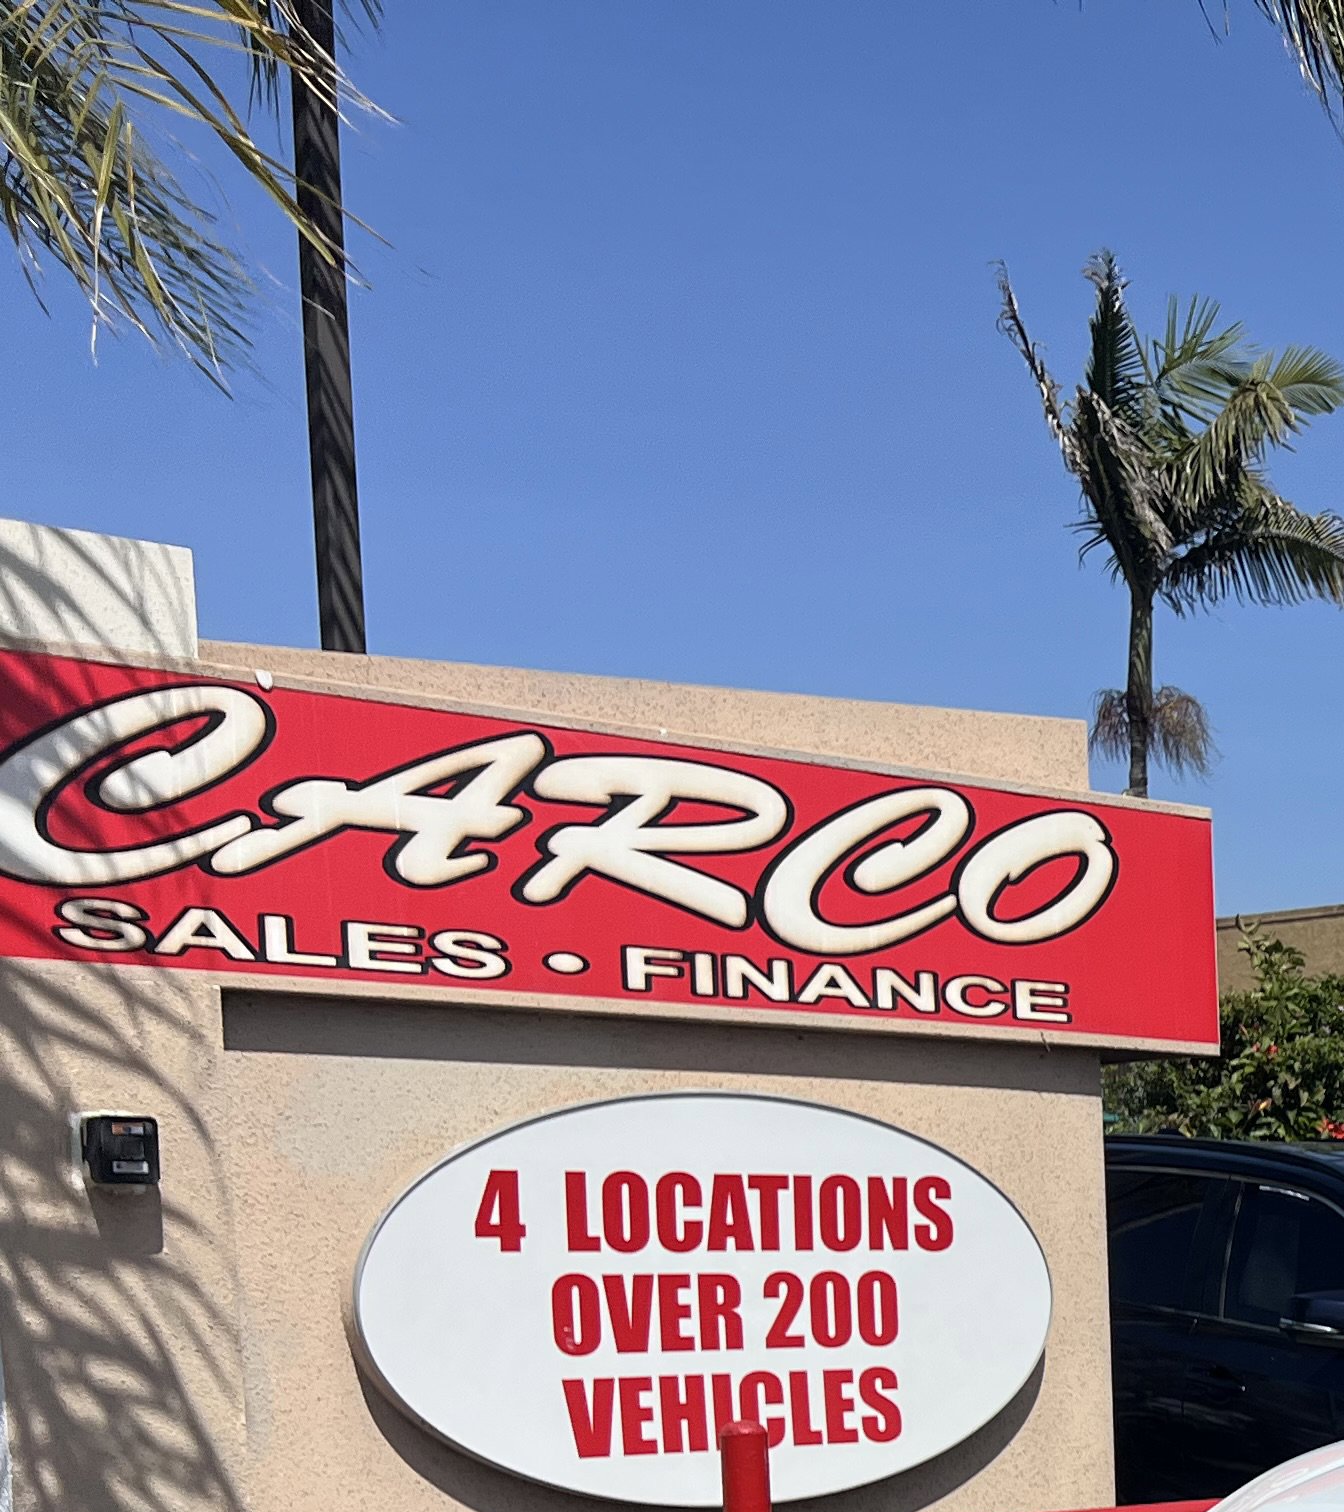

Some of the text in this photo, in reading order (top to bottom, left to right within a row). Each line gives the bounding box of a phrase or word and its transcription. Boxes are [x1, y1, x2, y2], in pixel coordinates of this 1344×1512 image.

[0, 681, 1118, 956] CARCO
[53, 897, 1072, 1024] SALES FINANCE
[474, 1169, 954, 1254] 4 LOCATIONS
[551, 1270, 899, 1356] OVER 200
[562, 1366, 903, 1458] VEHICLES
